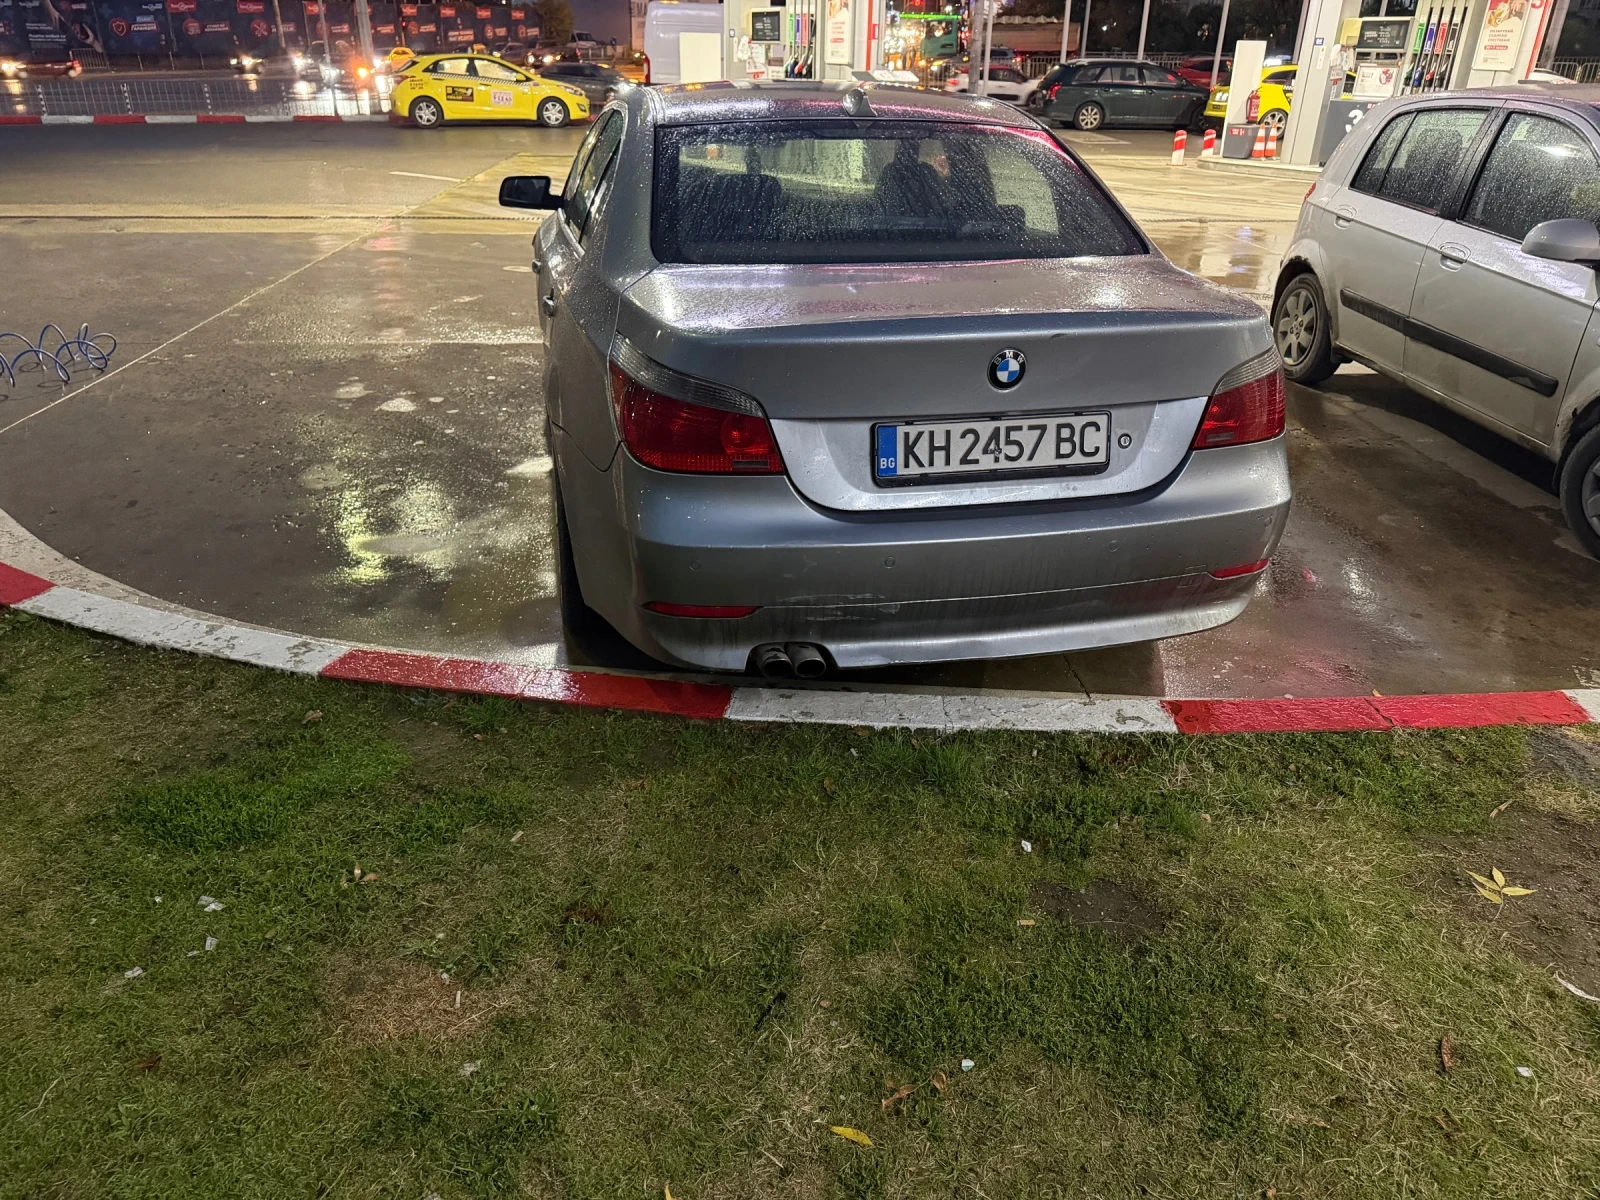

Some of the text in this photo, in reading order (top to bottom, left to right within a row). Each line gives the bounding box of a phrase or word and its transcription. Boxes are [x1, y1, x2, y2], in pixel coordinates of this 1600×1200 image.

[1345, 109, 1364, 134] 3
[994, 351, 1026, 366] BMW
[902, 421, 1101, 469] KH 2457 BC
[880, 457, 896, 469] BG
